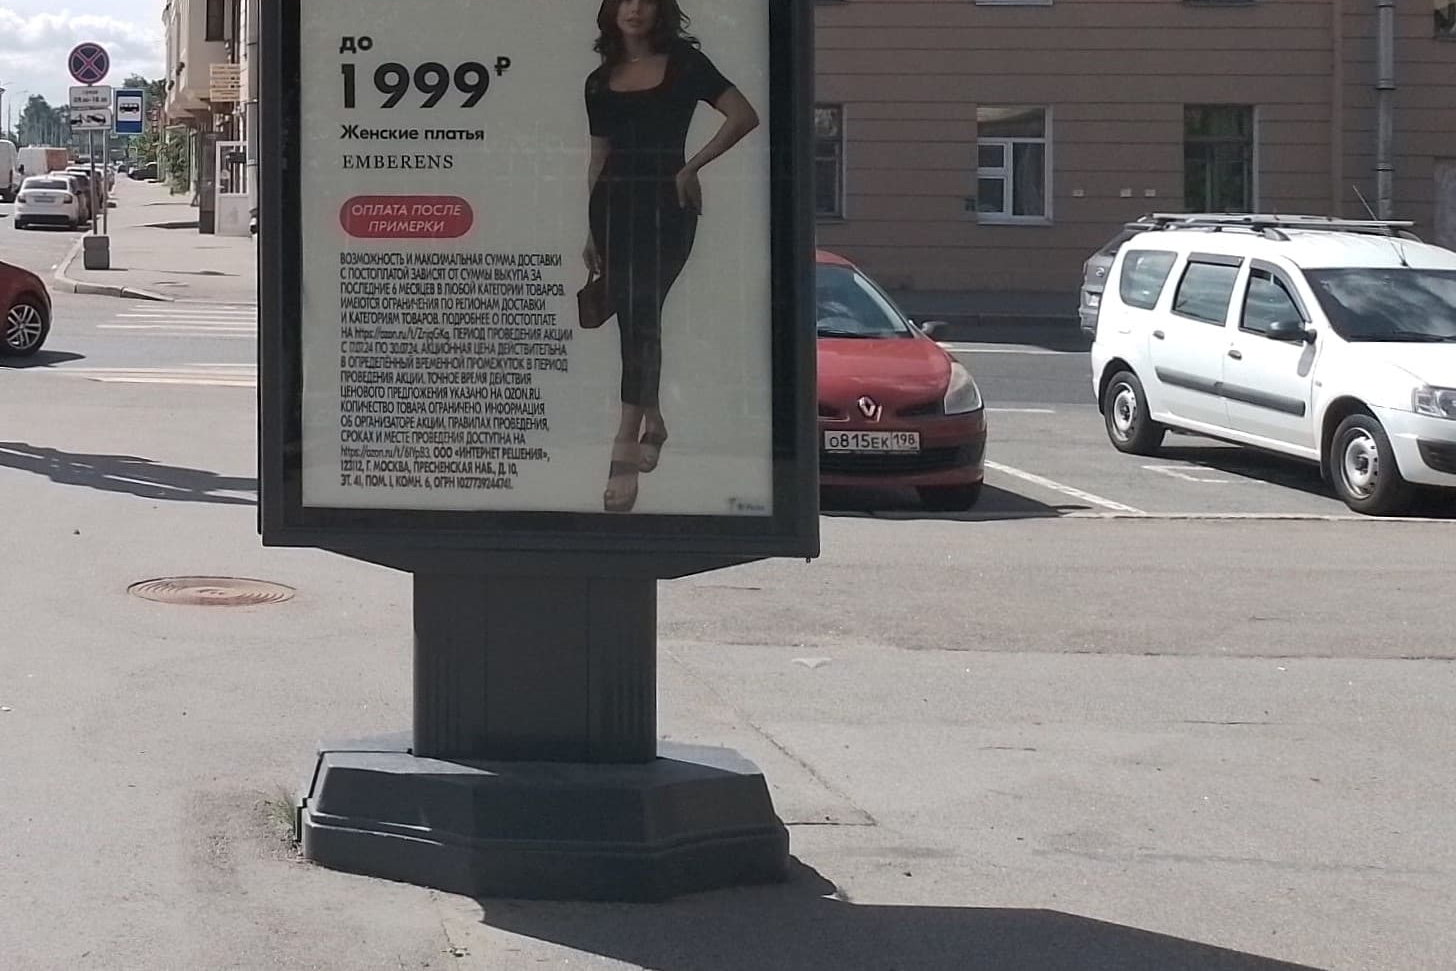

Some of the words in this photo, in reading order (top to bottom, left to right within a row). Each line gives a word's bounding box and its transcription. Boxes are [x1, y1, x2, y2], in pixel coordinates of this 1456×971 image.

[340, 124, 419, 140] Женские
[425, 128, 484, 140] платья
[342, 155, 454, 169] EMBERENS
[352, 205, 408, 215] ОПЛАТА
[411, 205, 462, 215] ПОСЛЕ
[369, 221, 445, 232] ПРИМЕРКИ
[340, 253, 404, 265] ВОЗМОЖНОСТЬ
[407, 254, 412, 264] И
[415, 254, 482, 265] МАКСИМАЛЬНАЯ
[485, 254, 515, 265] СУММА
[518, 254, 562, 267] ДОСТАВКИ
[348, 266, 409, 279] ПОСТОПЛАТОЙ
[411, 268, 446, 279] ЗАВИСЯТ
[448, 269, 458, 279] ОТ
[460, 269, 492, 280] СУММЫ
[495, 269, 529, 280] ВЫКУПА
[531, 269, 542, 281] ЗА
[341, 283, 390, 295] ПОСЛЕДНИЕ
[399, 283, 435, 296] МЕСЯЦЕВ
[445, 282, 475, 294] ЛЮБОЙ
[341, 298, 379, 309] ИМЕЮТСЯ
[382, 298, 438, 309] ОГРАНИЧЕНИЯ
[441, 298, 453, 309] ПО
[456, 298, 500, 309] РЕГИОНАМ
[501, 299, 545, 311] ДОСТАВКИ
[341, 312, 347, 323] И
[350, 312, 399, 323] КАТЕГОРИЯМ
[442, 313, 489, 325] ПОДРОБНЕЕ
[501, 314, 557, 325] ПОСТОПЛАТЕ
[341, 327, 353, 338] НА
[453, 328, 485, 340] ПЕРИОД
[488, 328, 541, 340] ПРОВЕДЕНИЯ
[474, 343, 495, 355] ЦЕНА
[341, 371, 393, 383] ПРОВЕДЕНИЯ
[428, 373, 459, 384] ТОЧНОЕ
[461, 373, 486, 384] ВРЕМЯ
[341, 386, 385, 398] ЦЕНОВОГО
[388, 386, 447, 399] ПРЕДЛОЖЕНИЯ
[450, 387, 488, 399] УКАЗАНО
[491, 388, 503, 399] НА
[341, 401, 394, 413] КОЛИЧЕСТВО
[397, 402, 426, 413] ТОВАРА
[485, 403, 545, 416] ИНФОРМАЦИЯ
[341, 415, 352, 427] ОБ
[355, 416, 414, 428] ОРГАНИЗАТОРЕ
[448, 417, 491, 429] ПРАВИЛАХ
[341, 430, 373, 442] СРОКАХ
[376, 431, 382, 442] И
[384, 432, 409, 443] МЕСТЕ
[412, 432, 464, 444] ПРОВЕДЕНИЯ
[513, 433, 525, 444] НА
[830, 434, 889, 448] О815ЕК
[894, 434, 915, 445] 198
[434, 447, 453, 458] ООО
[414, 462, 472, 473] ПРЕСНЕНСКАЯ
[434, 477, 454, 488] ОГРН
